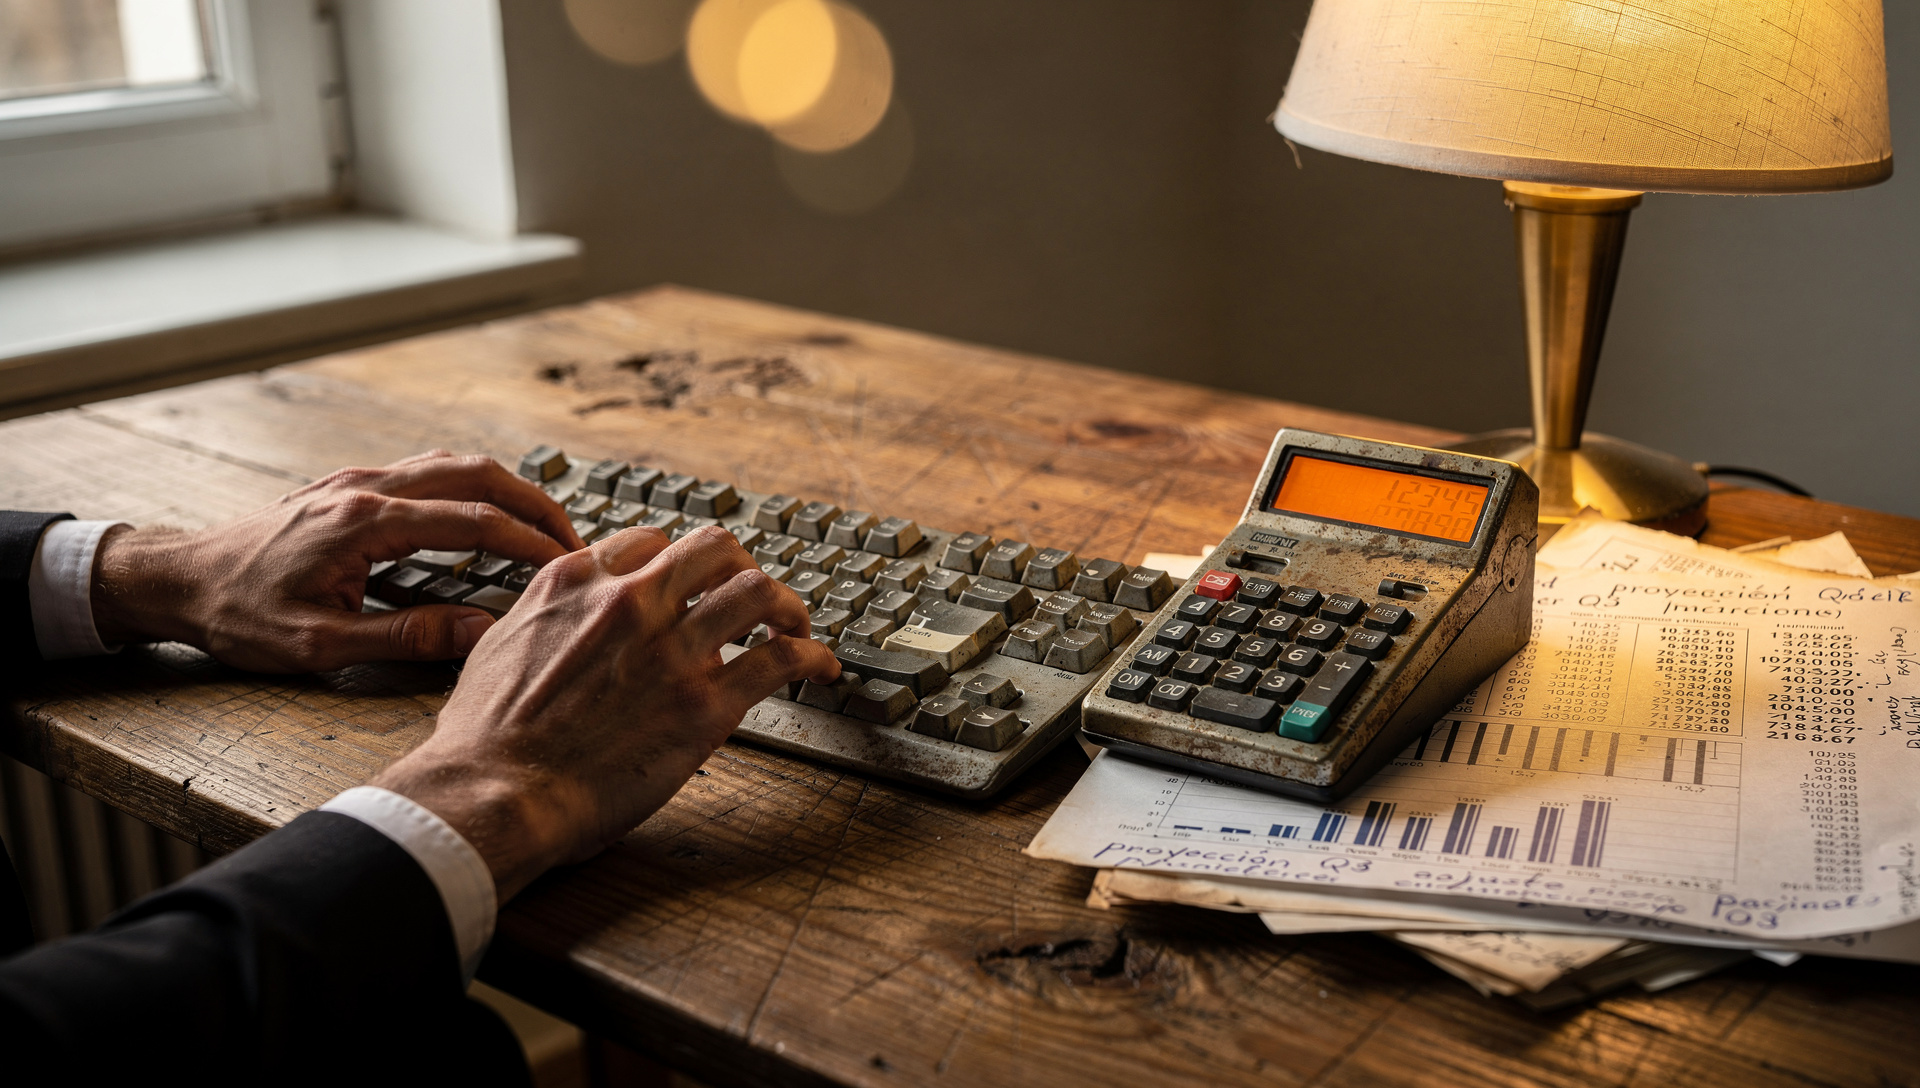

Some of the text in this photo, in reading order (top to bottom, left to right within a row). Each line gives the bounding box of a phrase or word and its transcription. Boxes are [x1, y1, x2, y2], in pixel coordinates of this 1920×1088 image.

[1386, 479, 1484, 515] 12345
[1229, 605, 1247, 617] 7
[1268, 615, 1286, 627] 8
[1165, 625, 1184, 637] 4
[1308, 623, 1326, 635] 9
[1206, 632, 1225, 644] 5
[1246, 640, 1264, 652] 5
[1140, 649, 1165, 661] AN
[1288, 649, 1308, 661] 6
[1188, 658, 1200, 669] 1
[1225, 666, 1245, 679] 2
[1118, 672, 1144, 686] ON
[1267, 675, 1286, 688] 3
[1093, 842, 1290, 868] proyección
[1320, 857, 1373, 874] Q3
